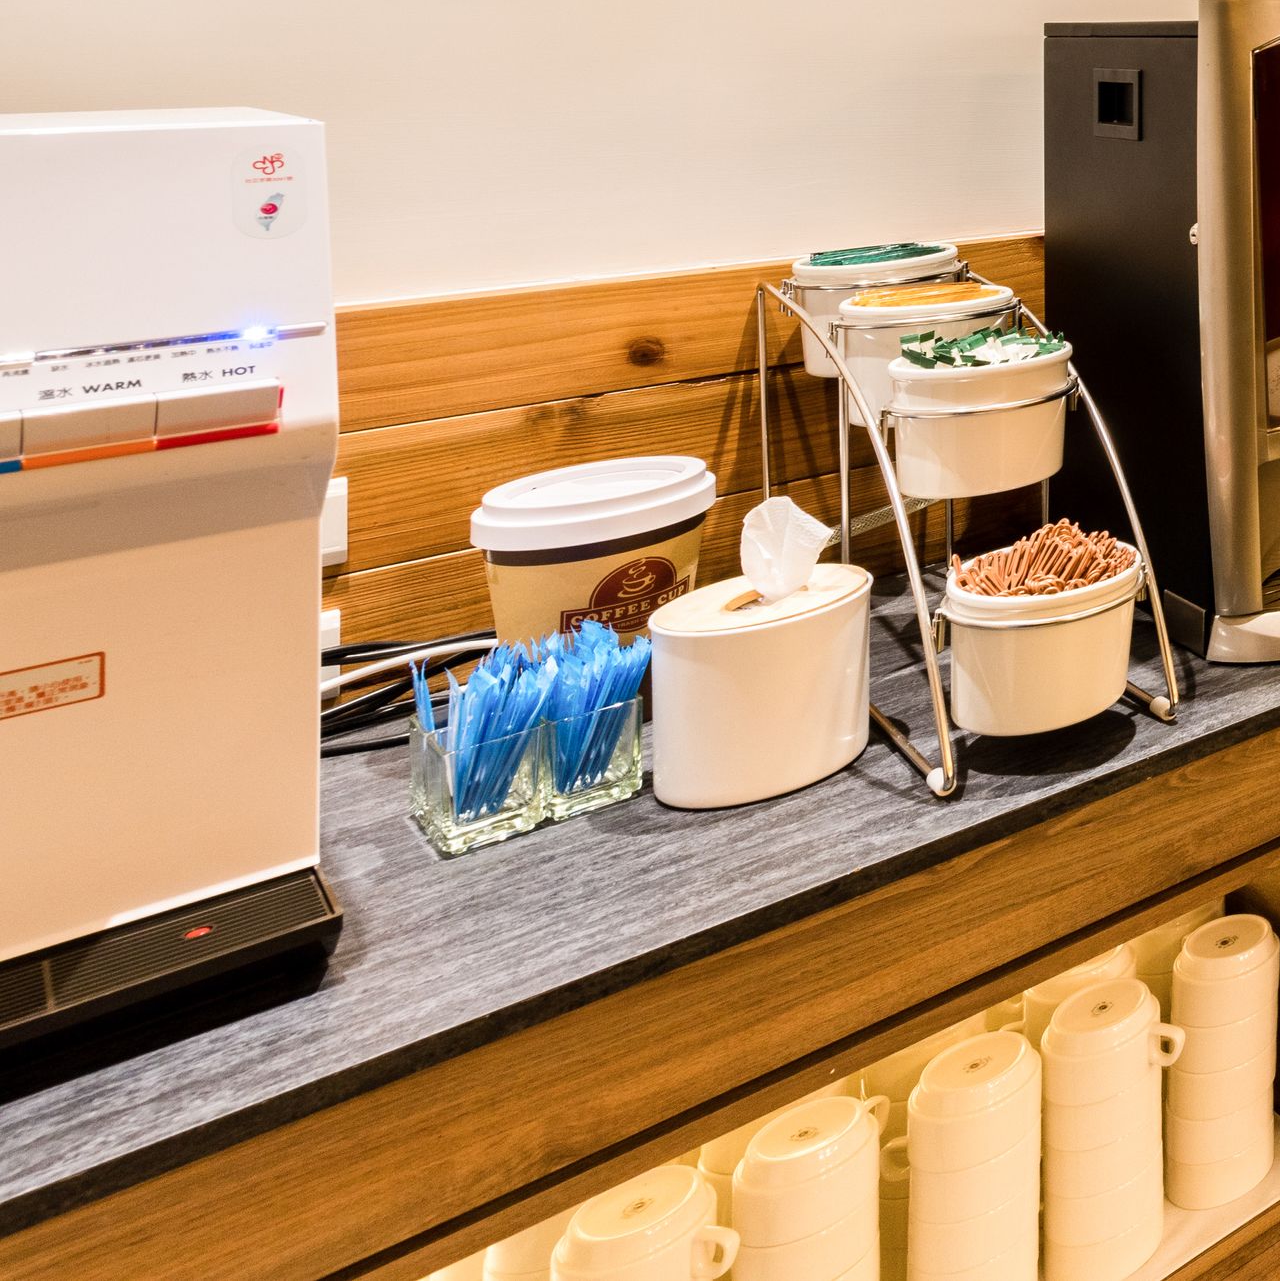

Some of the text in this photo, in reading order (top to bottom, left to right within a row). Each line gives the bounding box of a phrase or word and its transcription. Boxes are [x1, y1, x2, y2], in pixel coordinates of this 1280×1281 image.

[182, 365, 256, 383] 熱水 HOT
[82, 379, 142, 394] WARM
[657, 584, 685, 606] CUP
